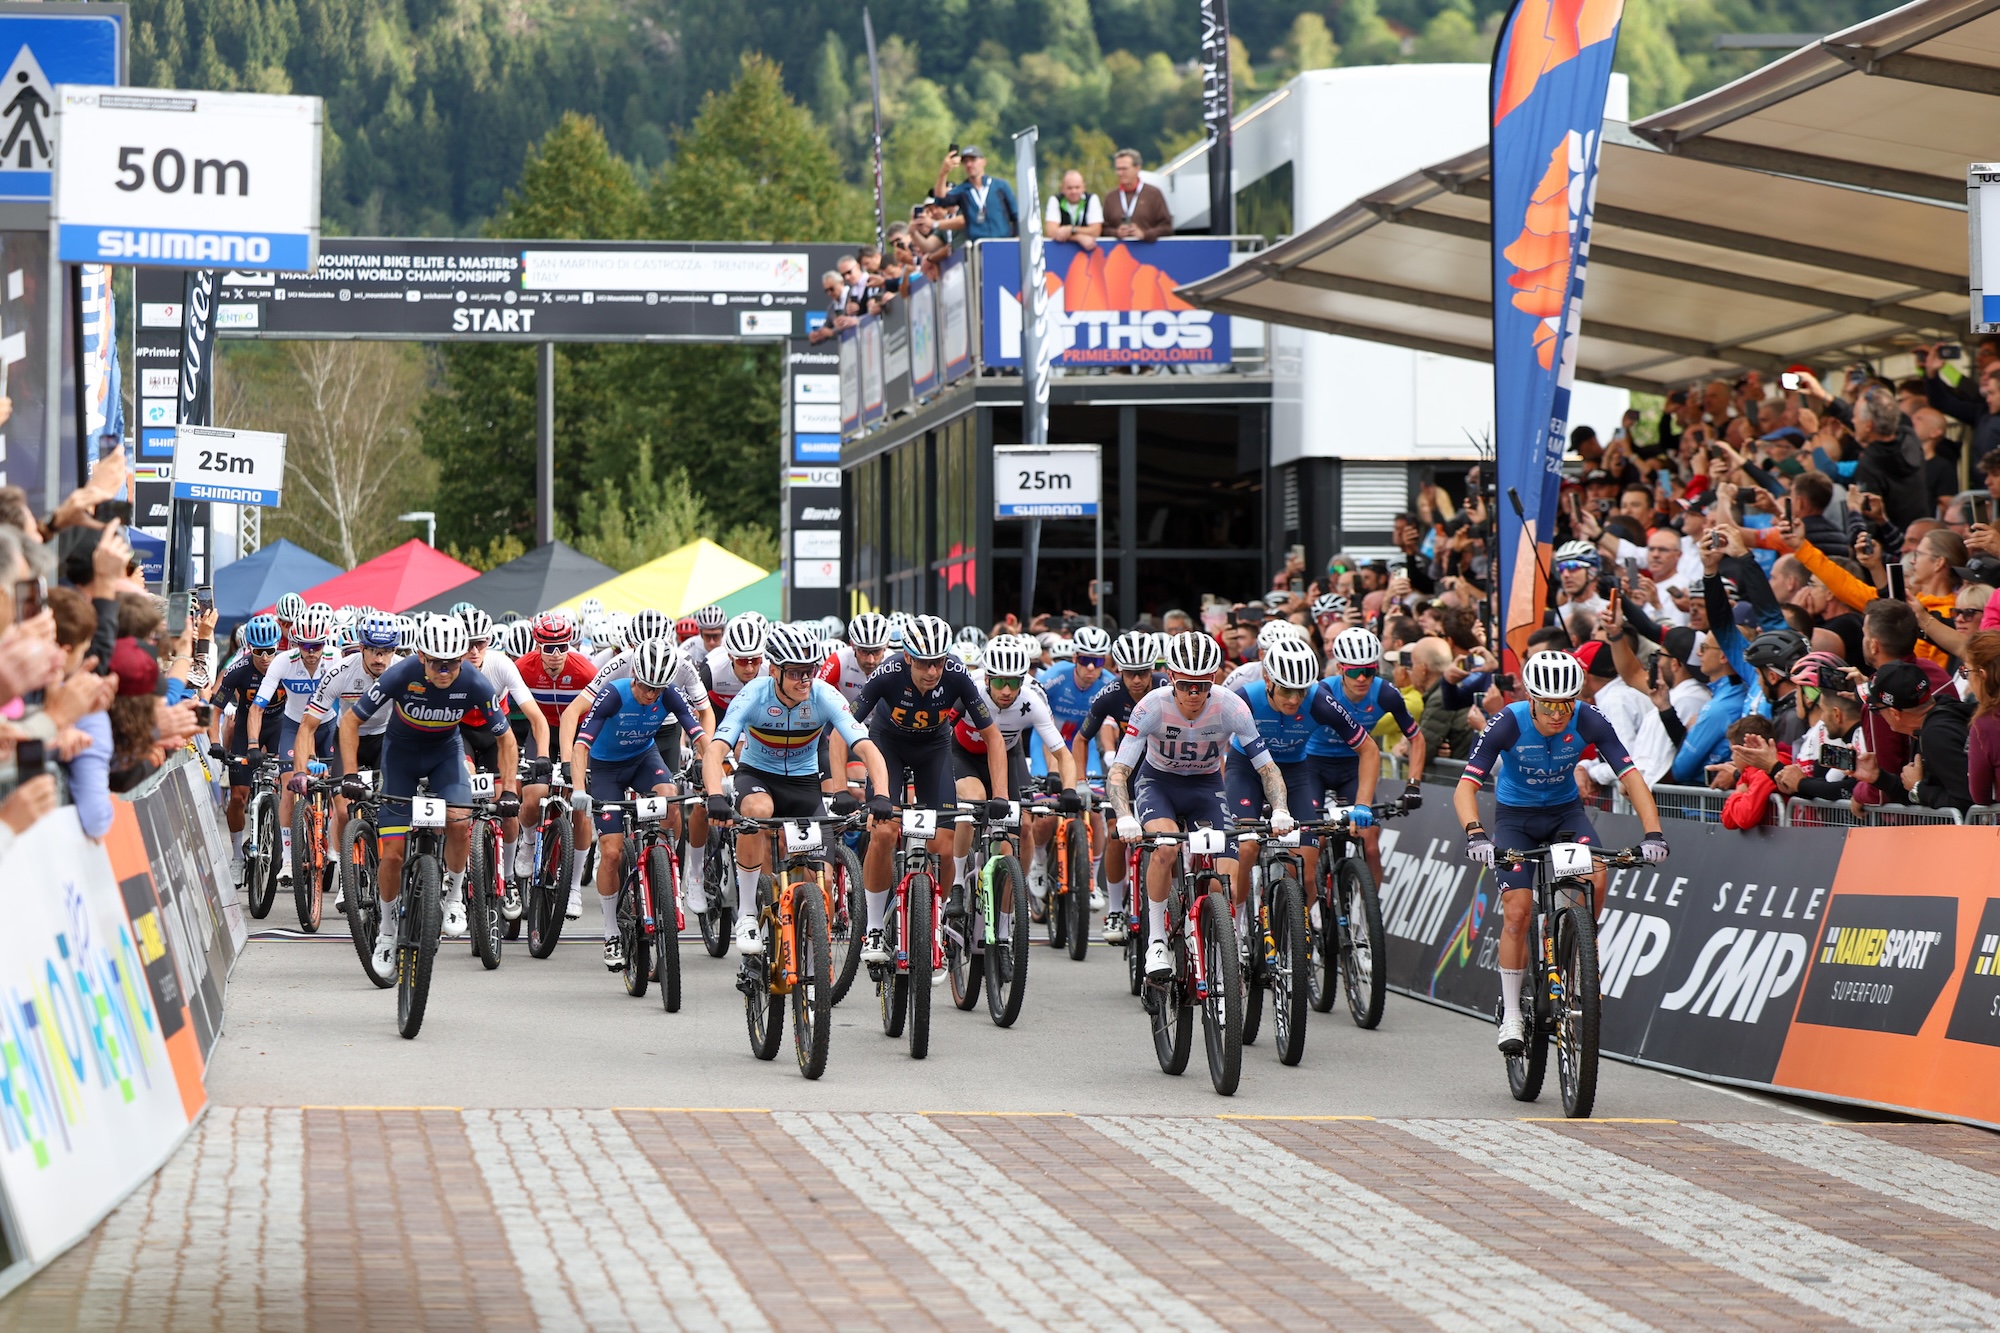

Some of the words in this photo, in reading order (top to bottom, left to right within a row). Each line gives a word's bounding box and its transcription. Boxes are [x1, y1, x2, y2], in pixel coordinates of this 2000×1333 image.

[115, 146, 249, 197] 50m
[98, 230, 271, 263] SHIMANO
[316, 255, 377, 268] MOUNTAIN
[383, 255, 411, 268] BIKE
[413, 256, 444, 269] ELITE
[447, 257, 457, 269] &
[459, 257, 519, 270] MASTERS
[280, 269, 357, 281] MARATHON
[358, 269, 404, 282] WORLD
[405, 270, 511, 283] CHAMPIONSHIPS
[452, 309, 535, 332] START
[184, 269, 214, 402] Wili
[199, 450, 254, 474] 25m
[811, 471, 840, 483] UCI
[1018, 471, 1072, 489] 25m
[190, 485, 262, 503] SHIMANO
[1012, 505, 1083, 516] SHIMANO
[403, 703, 464, 723] Colombia
[1325, 695, 1357, 730] CASTELLI
[1469, 712, 1505, 760] CASTELLI
[1159, 740, 1220, 762] USA
[1518, 762, 1574, 776] ITALIA
[472, 777, 489, 791] 10
[424, 802, 434, 817] 5
[647, 799, 658, 813] 4
[914, 813, 925, 829] 2
[797, 828, 809, 841] 3
[1203, 832, 1211, 850] 1
[1564, 848, 1576, 865] 7
[1609, 868, 1689, 908] ELLE
[1712, 881, 1826, 920] SELLE
[1597, 907, 1671, 999] MP
[1660, 926, 1808, 1025] SMP
[1831, 980, 1894, 1005] SUPERFOOD
